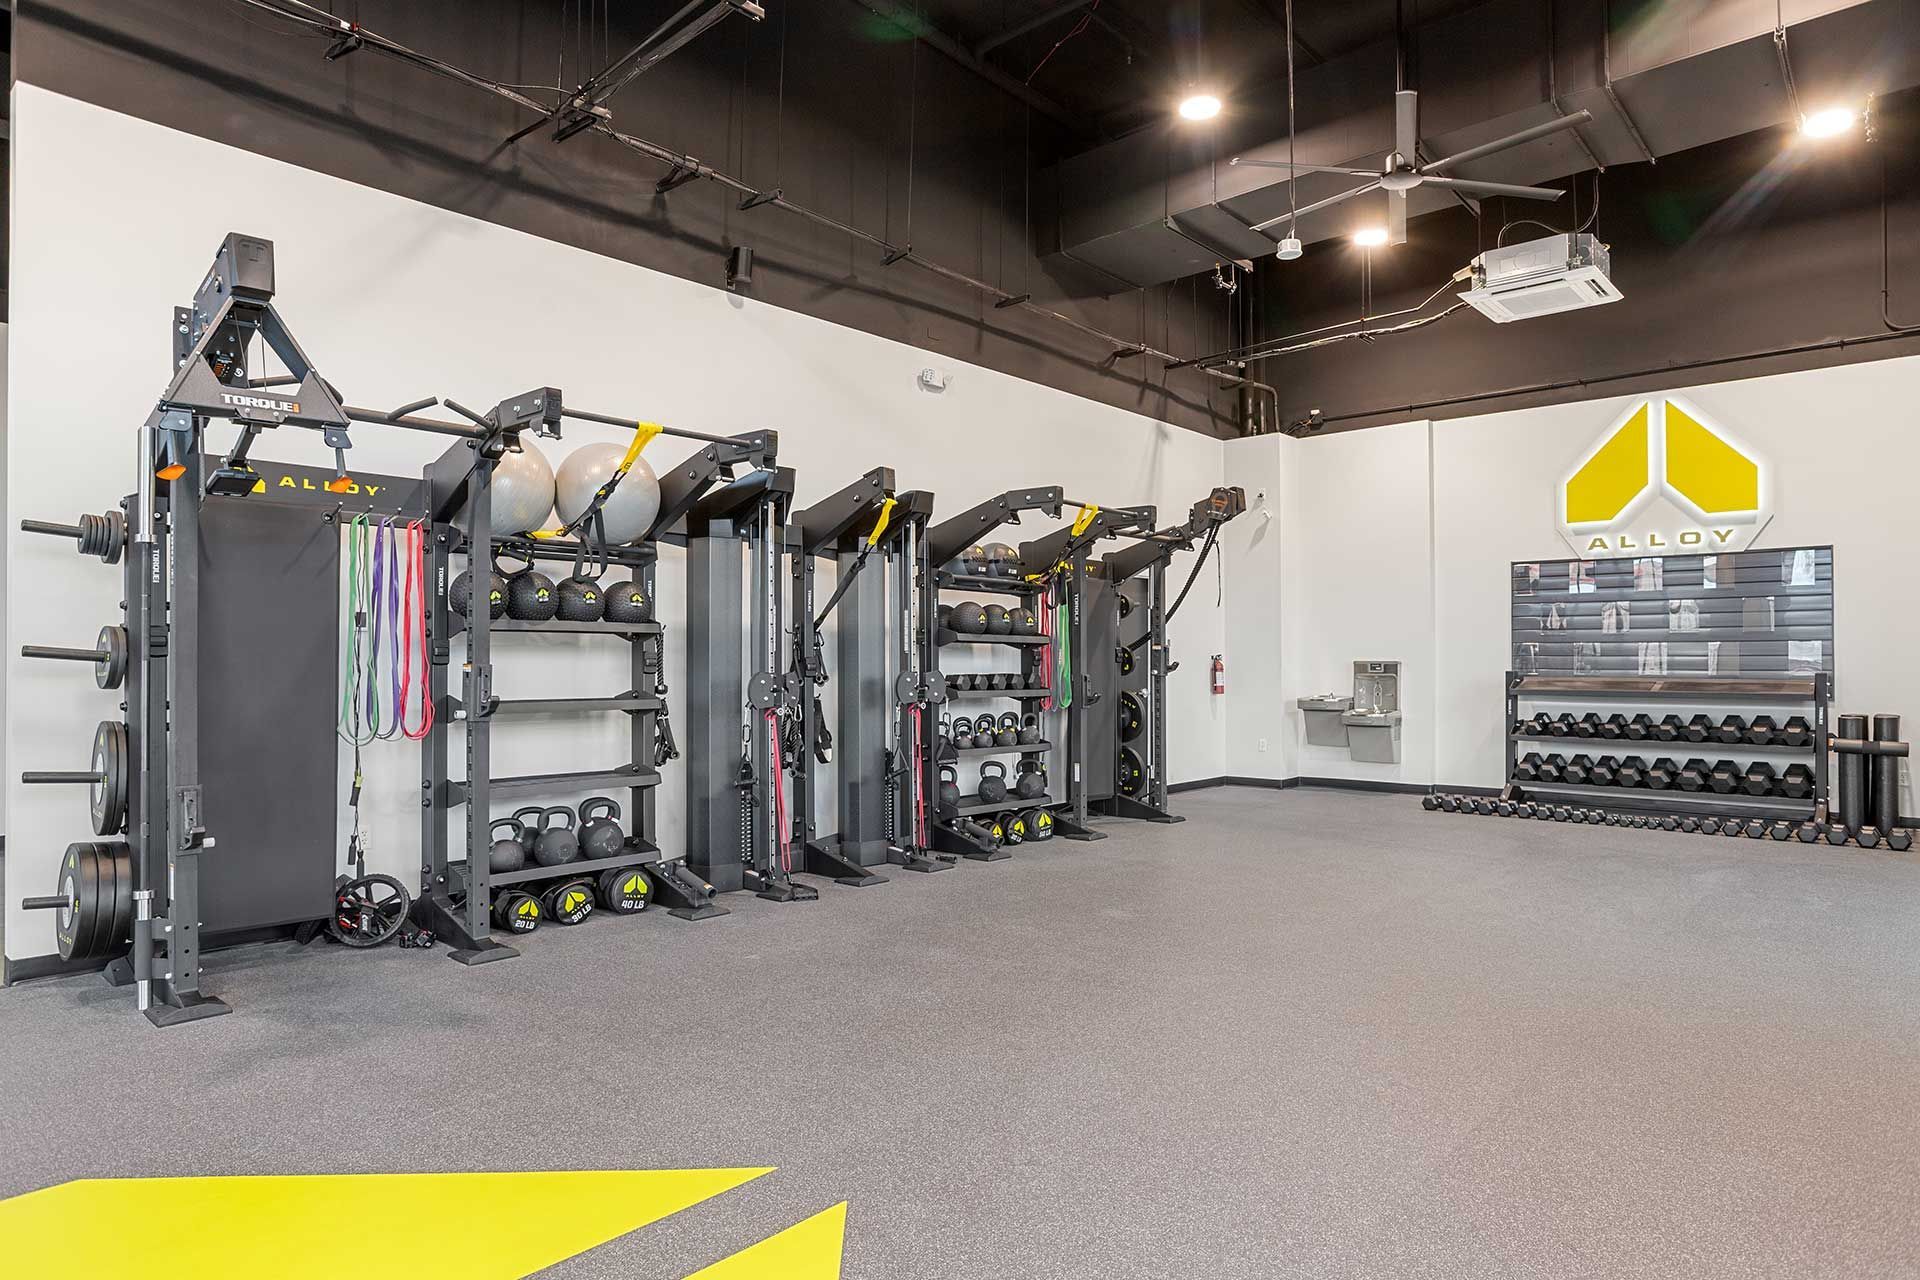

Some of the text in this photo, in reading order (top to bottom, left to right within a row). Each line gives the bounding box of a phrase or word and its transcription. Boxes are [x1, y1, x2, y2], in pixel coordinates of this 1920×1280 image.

[220, 393, 294, 412] TORQUE
[1588, 529, 1734, 550] ALLOY
[152, 549, 160, 581] TORQUE
[581, 903, 592, 915] LB
[621, 900, 645, 909] 40 LB
[515, 920, 535, 929] 20 LB
